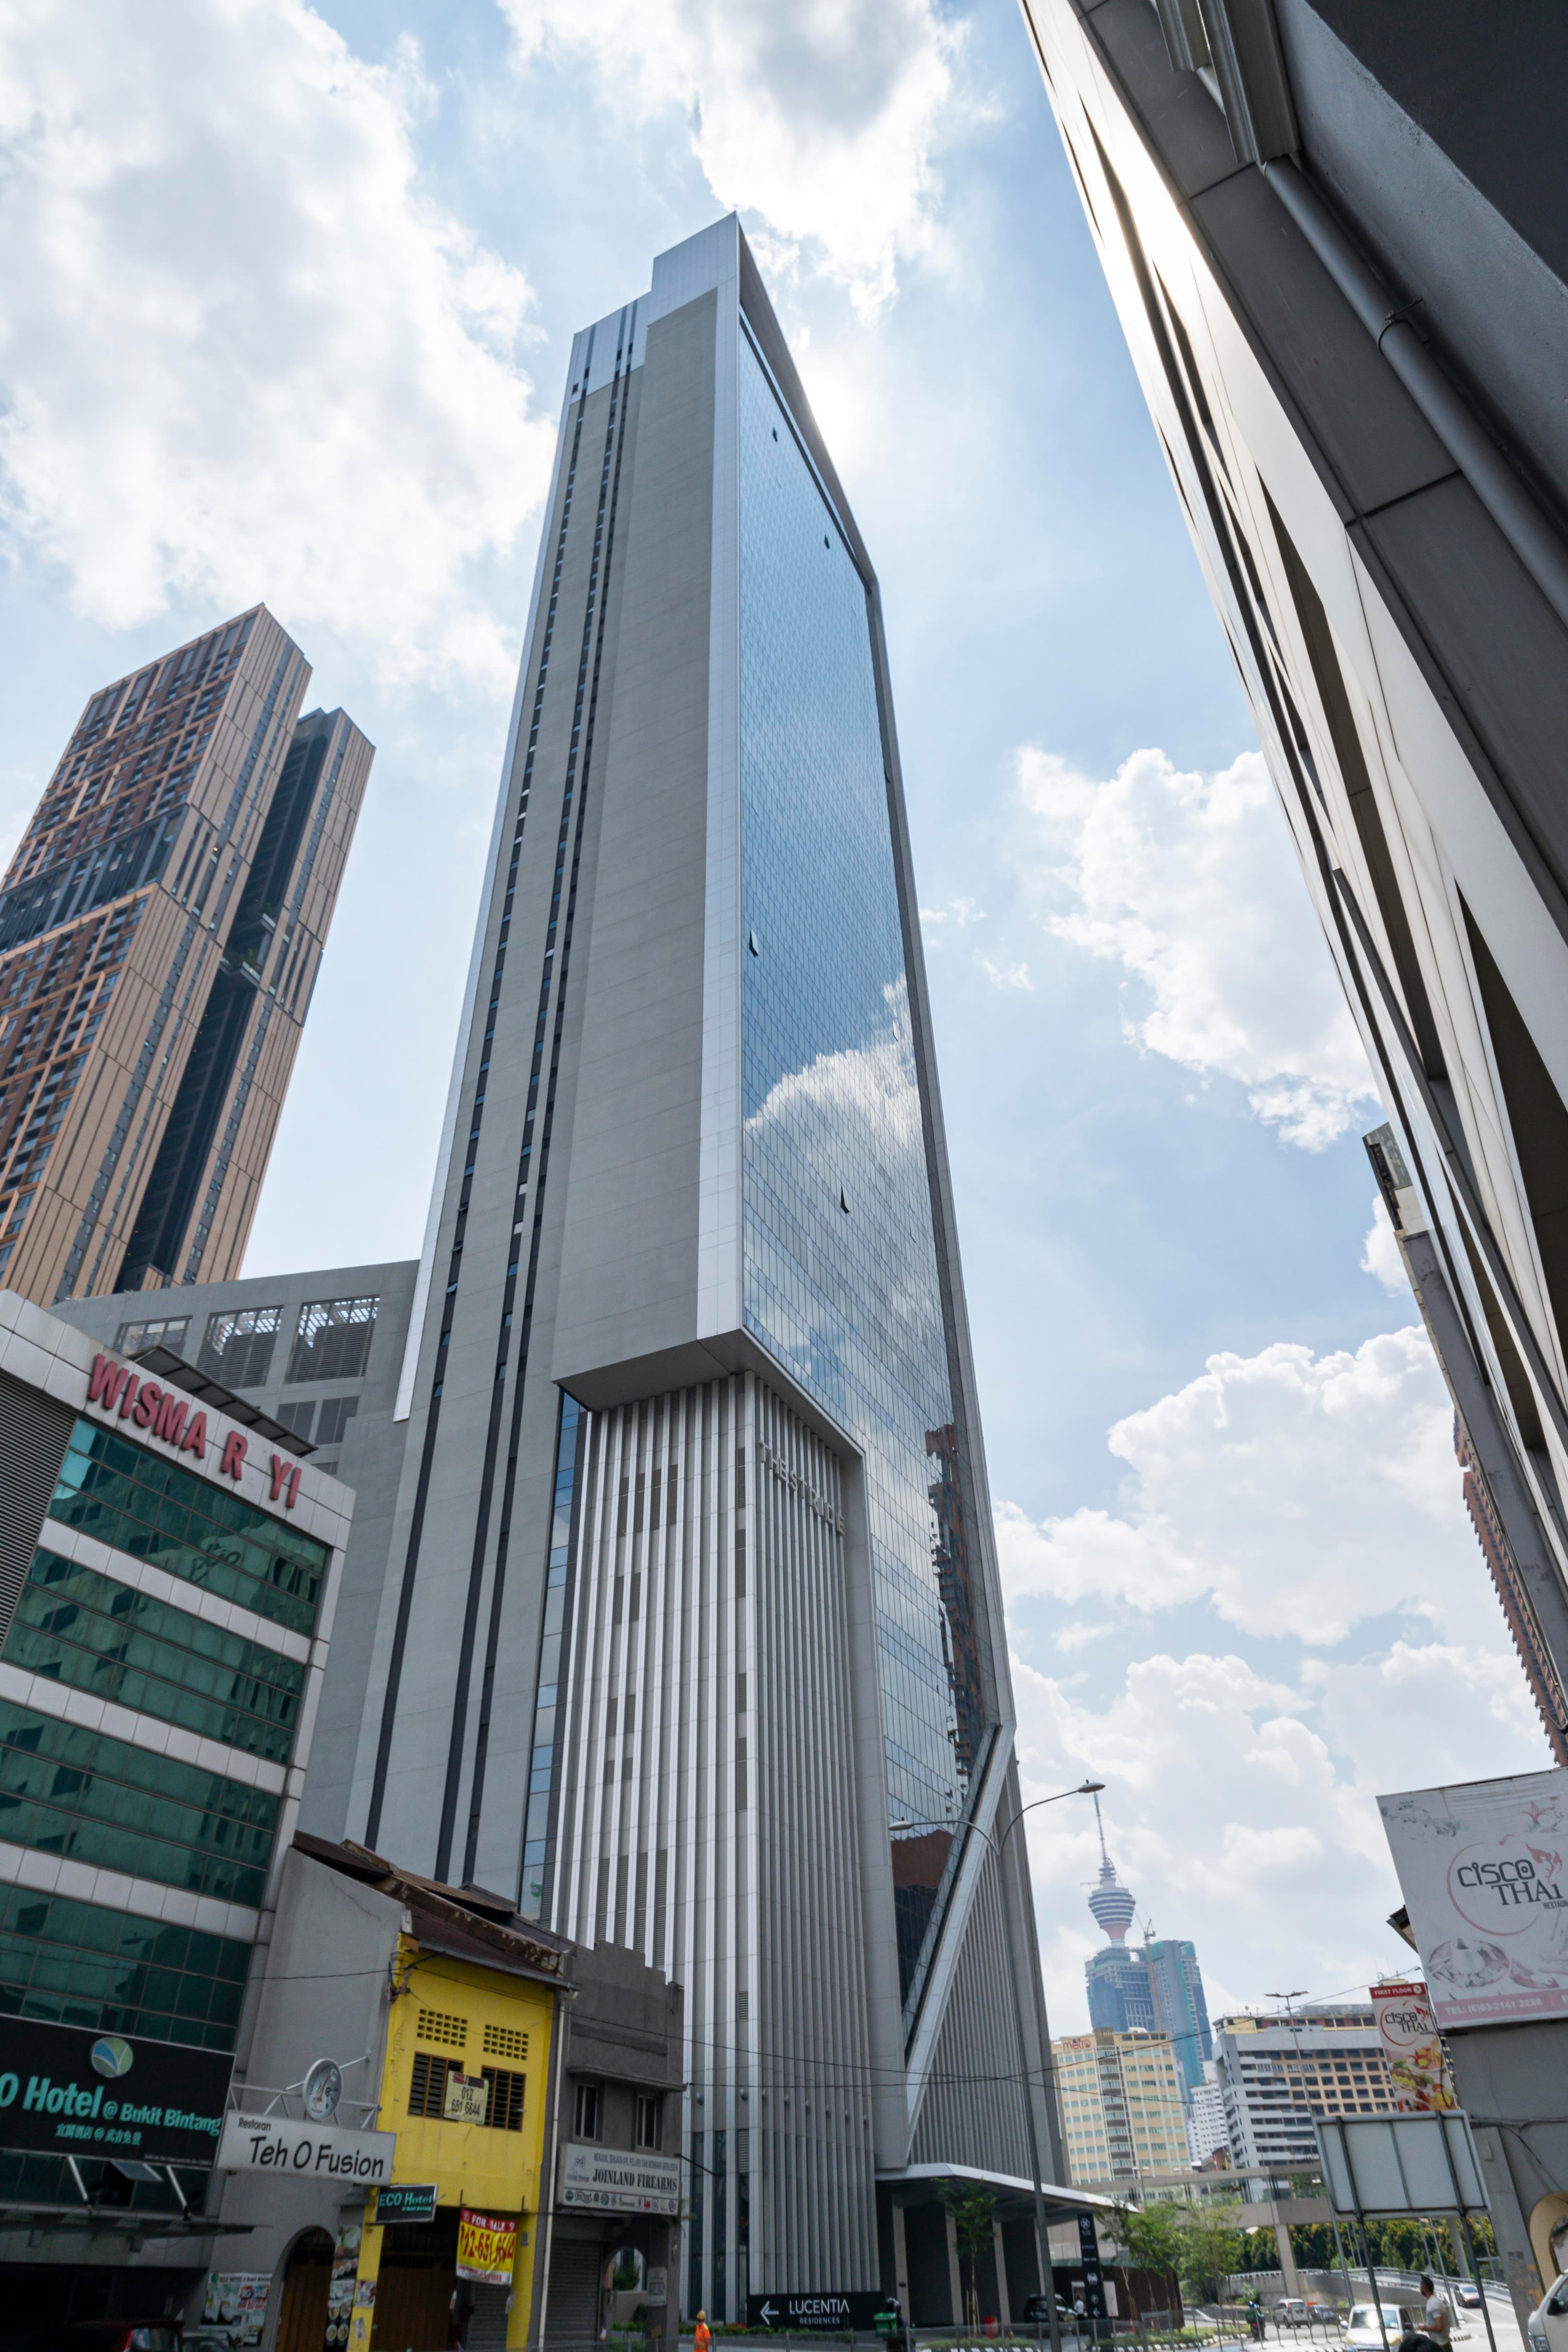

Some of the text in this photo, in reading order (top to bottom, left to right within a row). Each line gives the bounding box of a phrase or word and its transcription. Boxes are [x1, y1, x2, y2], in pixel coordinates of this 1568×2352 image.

[88, 1353, 302, 1509] WISMA R YI
[461, 2087, 474, 2101] 012
[22, 2075, 104, 2119] Hotel
[102, 2100, 118, 2120] @
[119, 2102, 162, 2126] Bukit
[163, 2109, 222, 2137] Bintang
[238, 2117, 272, 2132] Restoran
[250, 2135, 384, 2178] Teh O Fusion
[592, 2168, 635, 2187] JOINLAND
[637, 2173, 677, 2191] FIREARMS
[379, 2192, 432, 2207] ECO Hotel
[472, 2214, 486, 2228] FOR
[490, 2219, 505, 2232] SALE
[790, 2299, 850, 2314] LUCENTIA
[799, 2317, 840, 2325] RESIDENCES
